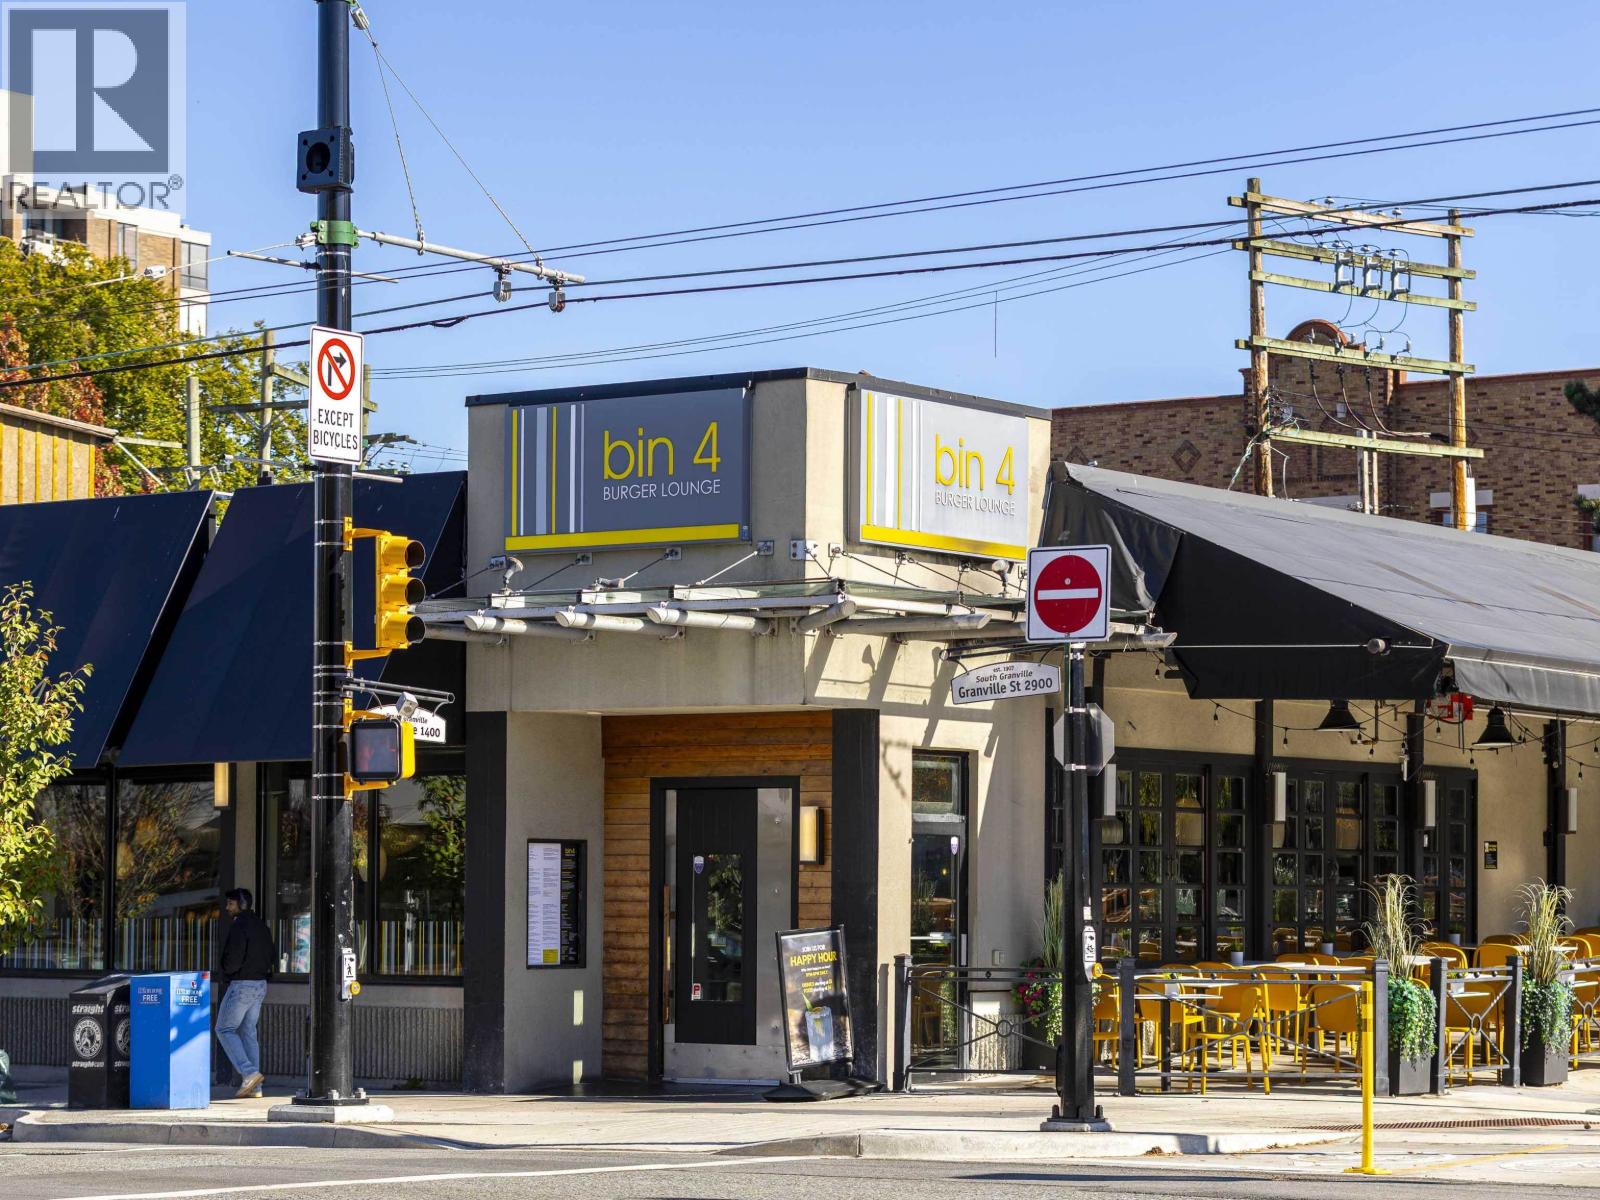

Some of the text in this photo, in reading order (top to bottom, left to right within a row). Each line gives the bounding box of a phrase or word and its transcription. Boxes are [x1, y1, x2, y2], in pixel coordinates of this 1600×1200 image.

[318, 408, 354, 428] EXCEPT
[313, 429, 358, 450] BICYCLES
[603, 421, 721, 480] bin 4
[935, 432, 1016, 496] bin 4
[603, 479, 721, 501] BURGER LOUNGE
[935, 491, 1016, 517] BURGER LOUNGE
[976, 670, 1033, 683] South Granville
[958, 678, 1053, 699] Granville St 2900
[420, 726, 441, 738] 1400
[790, 950, 838, 967] HAPPY HOUR
[142, 994, 159, 1002] FREE
[181, 996, 198, 1004] FREE
[72, 1003, 104, 1015] straight
